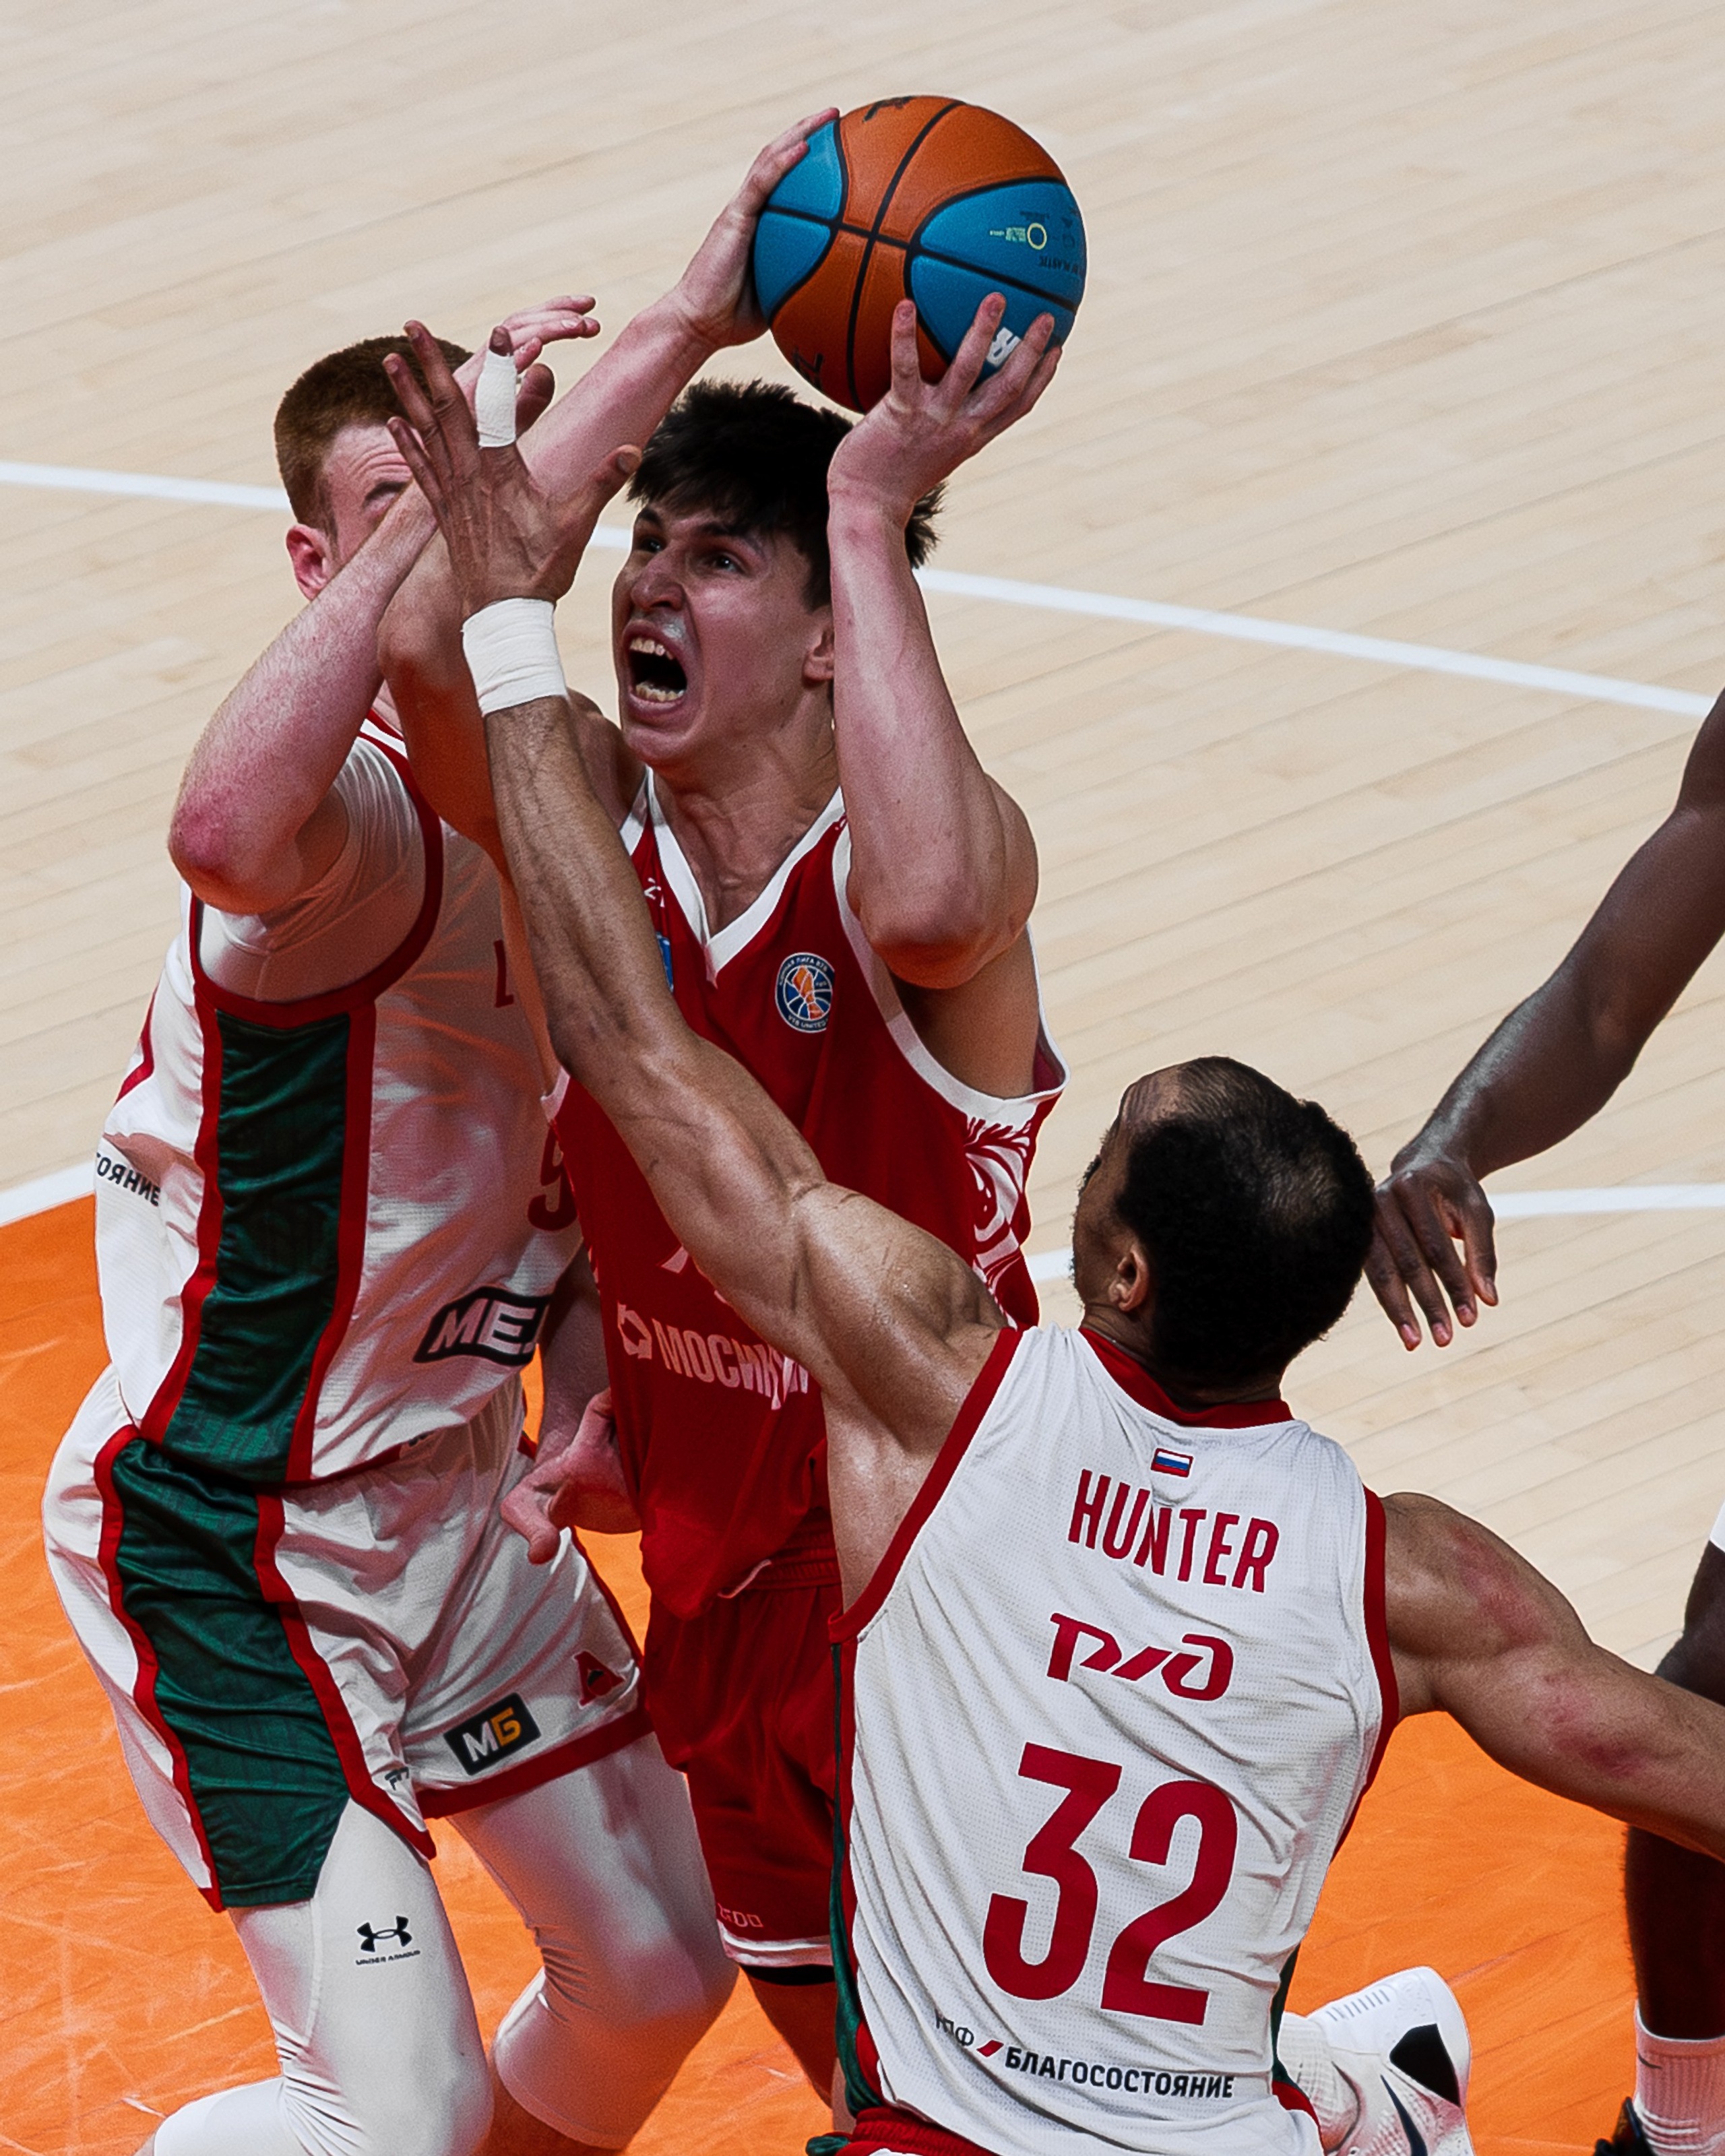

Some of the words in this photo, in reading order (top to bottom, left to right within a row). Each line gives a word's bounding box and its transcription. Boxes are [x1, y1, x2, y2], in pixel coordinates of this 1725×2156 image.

[96, 1151, 160, 1207] ОЯНИЕ
[1068, 1469, 1279, 1593] HUNTER
[982, 1742, 1237, 2025] 32
[1005, 2046, 1234, 2099] БЛАГОСОСТОЯНИЕ
